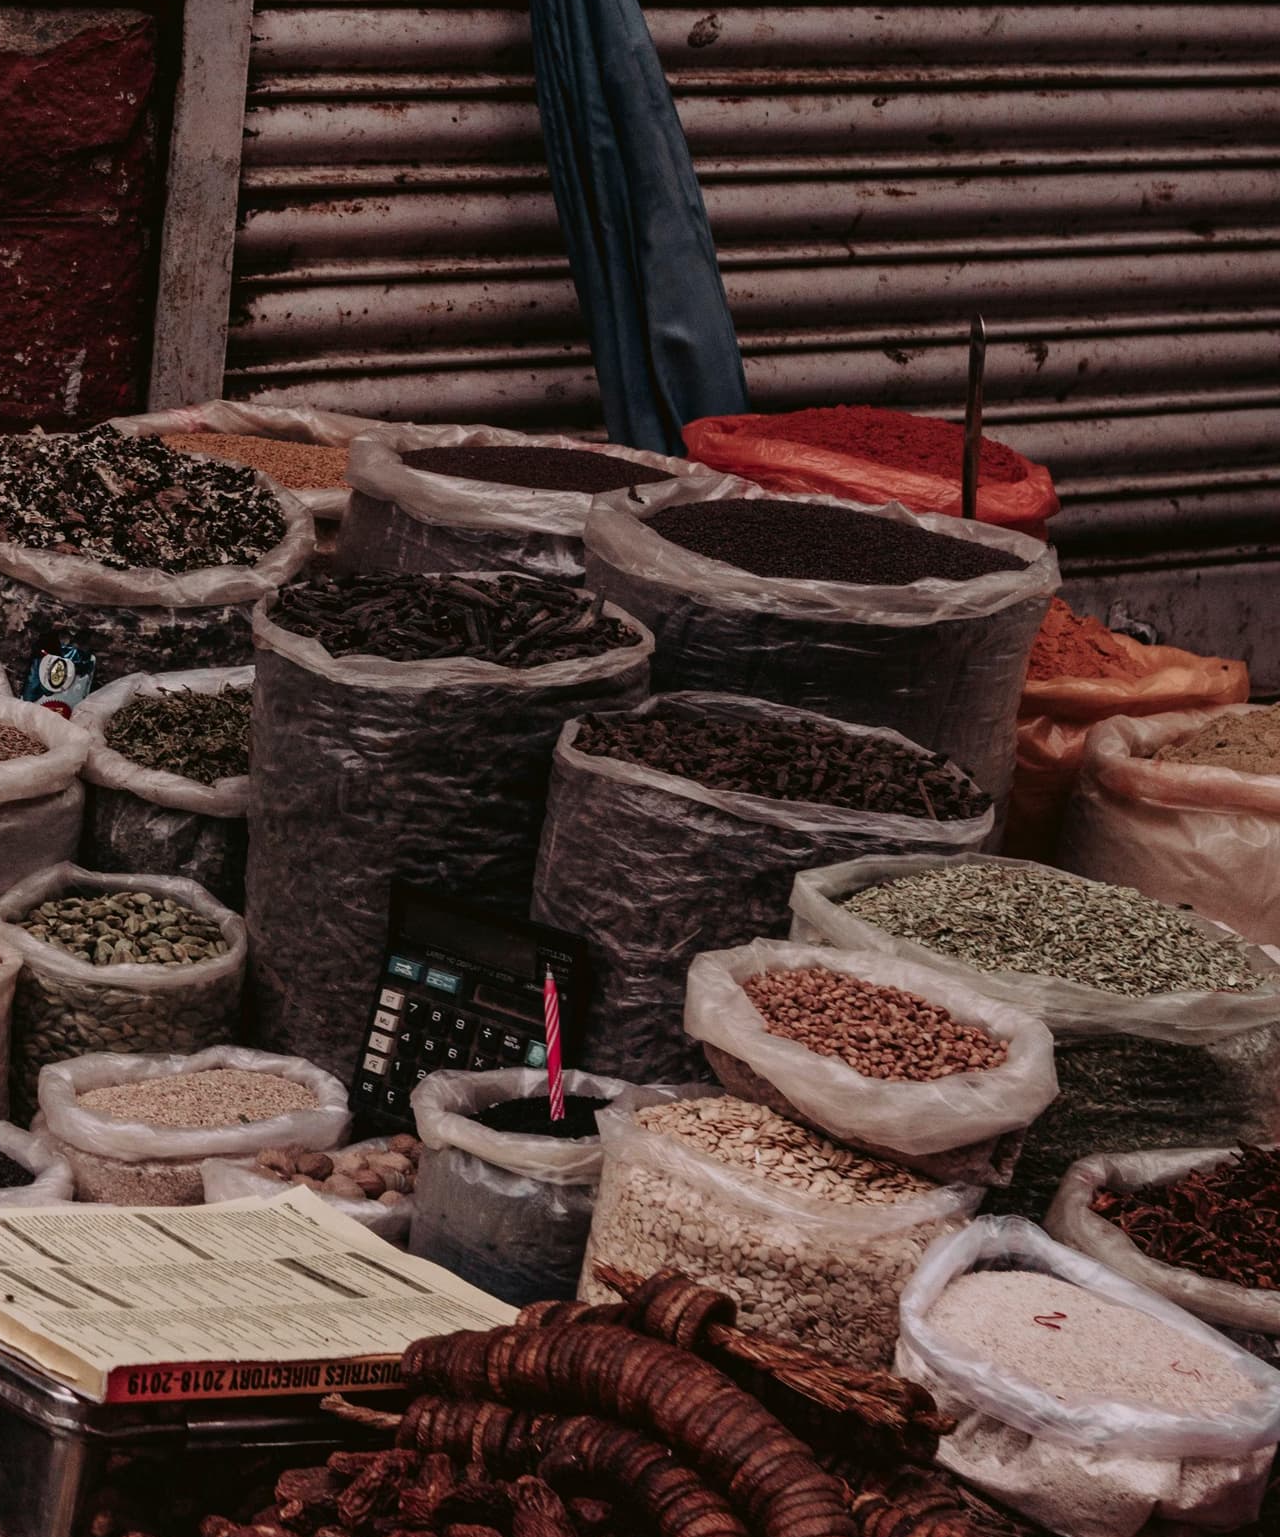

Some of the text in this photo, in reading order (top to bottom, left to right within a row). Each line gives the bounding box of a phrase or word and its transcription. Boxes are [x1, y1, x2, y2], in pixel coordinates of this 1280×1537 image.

[408, 1002, 419, 1014] 7
[431, 1010, 442, 1022] 8
[455, 1018, 465, 1030] 9
[400, 1032, 411, 1042] 4
[424, 1039, 435, 1052] 5
[447, 1048, 458, 1059] 6
[394, 1061, 427, 1081] 1 2
[127, 1368, 226, 1395] 2018-2019
[227, 1366, 322, 1392] DIRECTORY
